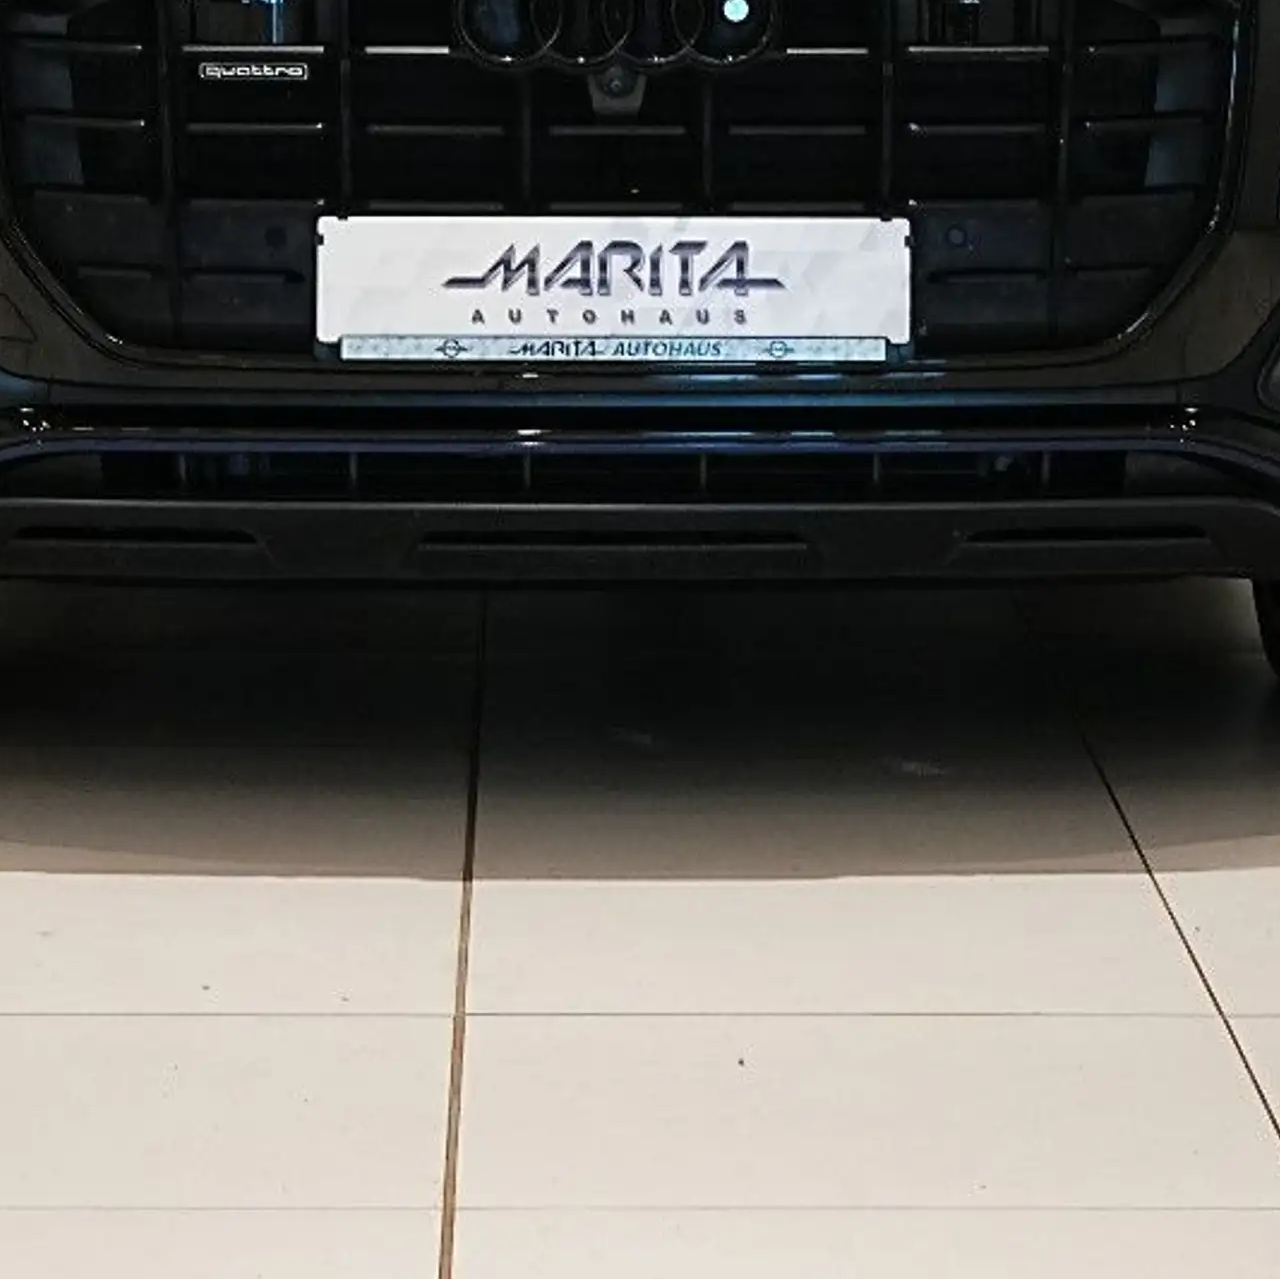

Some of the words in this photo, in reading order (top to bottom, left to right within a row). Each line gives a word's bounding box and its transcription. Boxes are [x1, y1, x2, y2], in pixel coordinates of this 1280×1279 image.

[205, 64, 303, 79] quattro
[439, 239, 787, 297] MARITA
[471, 308, 748, 326] AUTOHAUS
[510, 339, 605, 357] MARITA
[611, 339, 721, 357] AUTOHAUS
